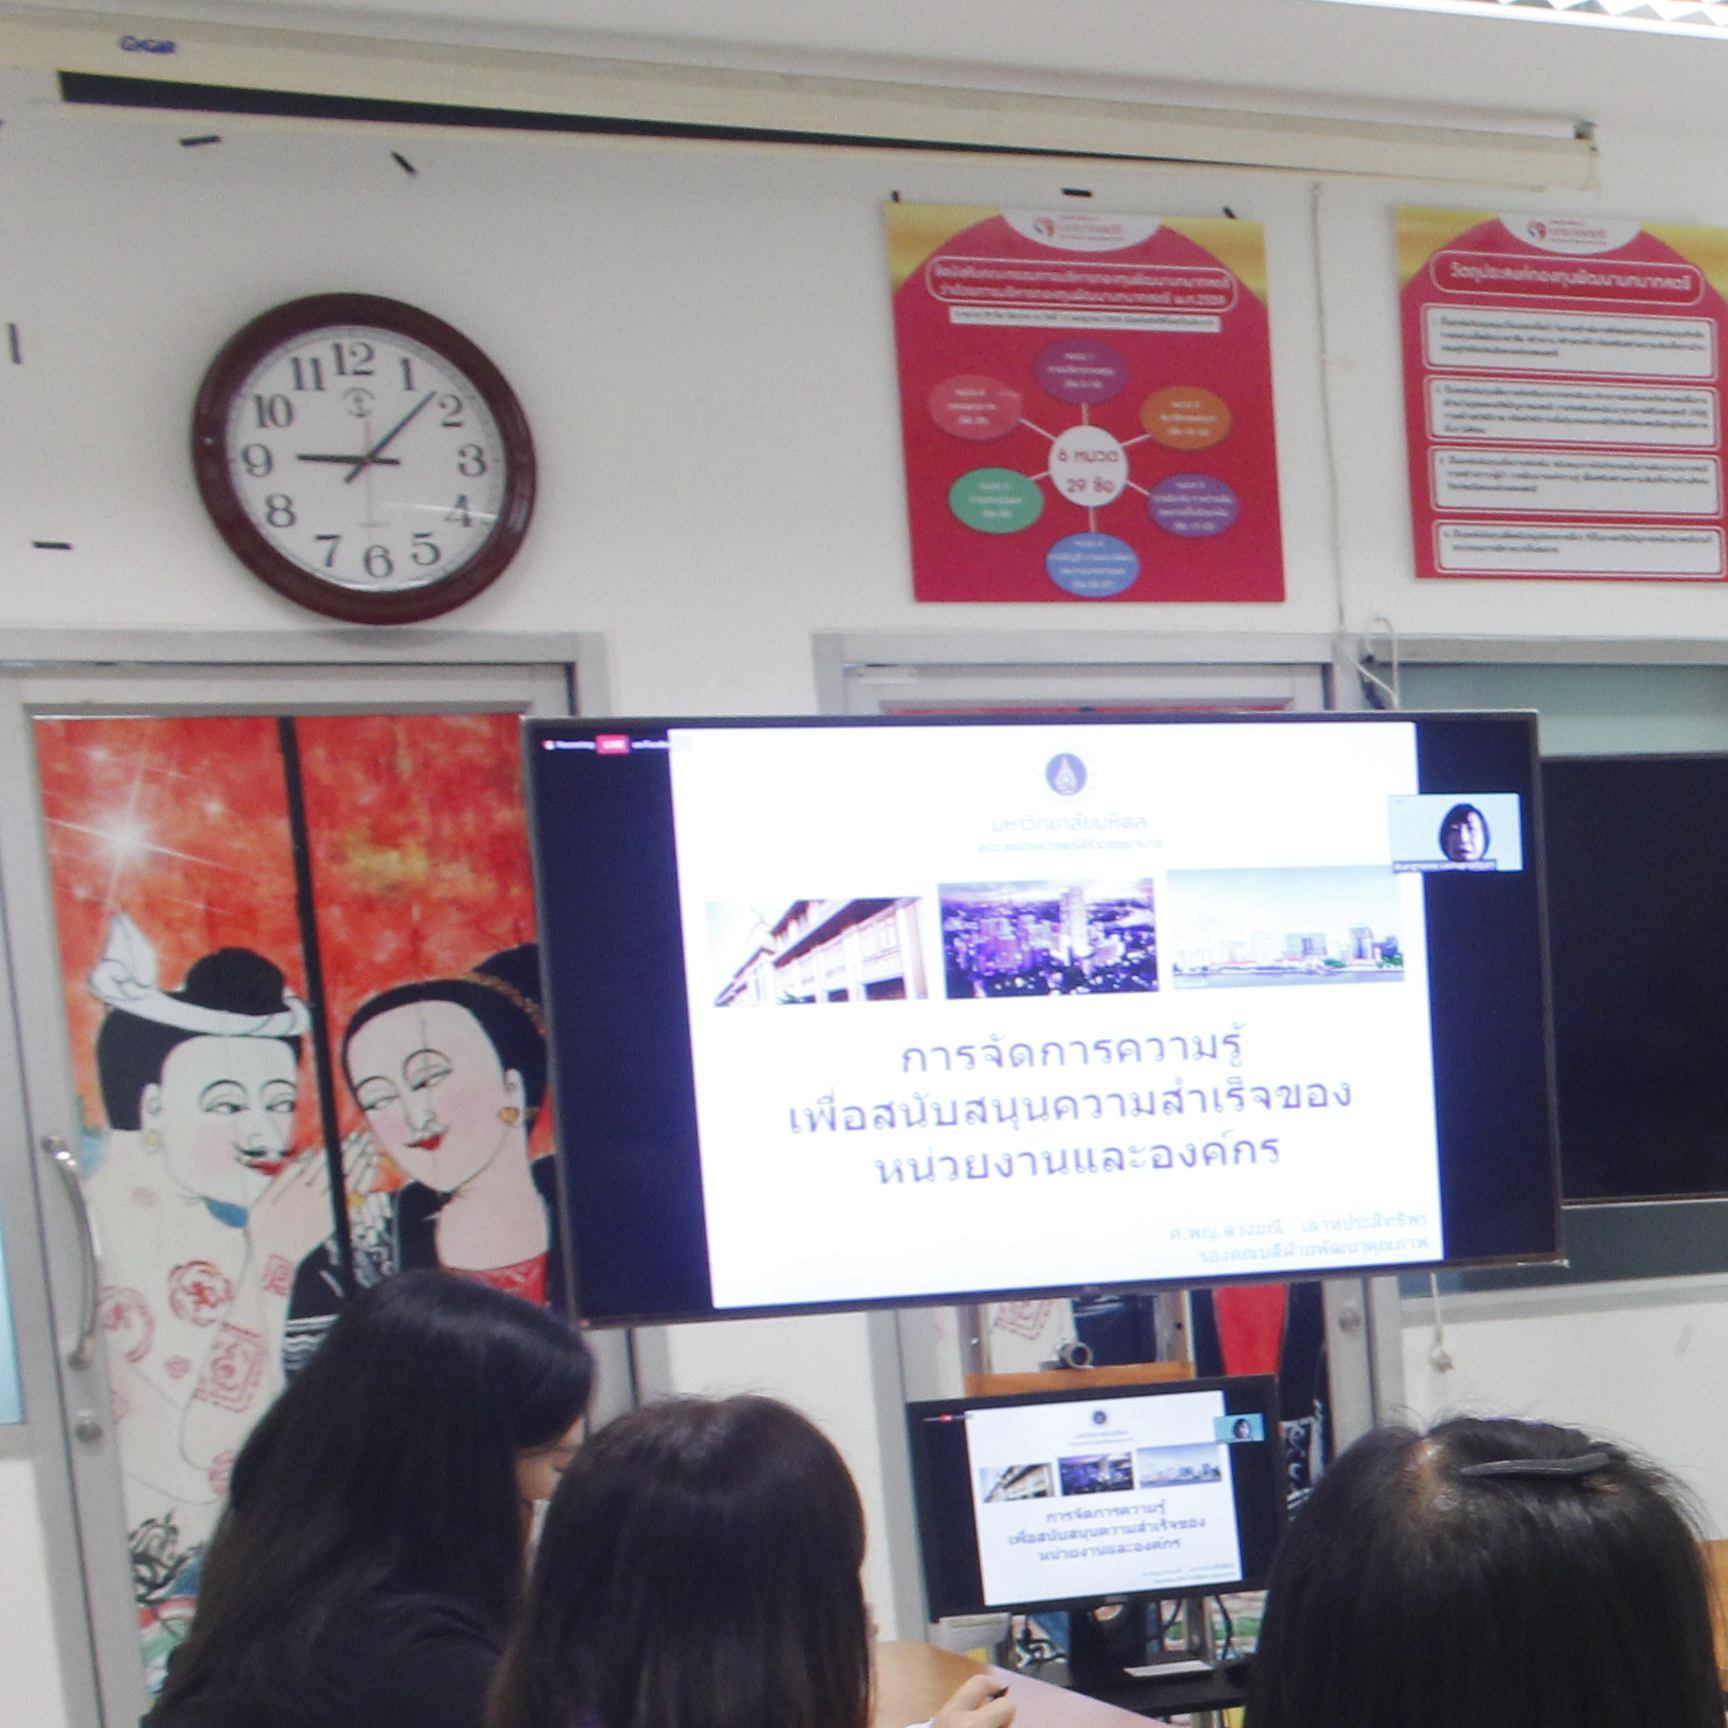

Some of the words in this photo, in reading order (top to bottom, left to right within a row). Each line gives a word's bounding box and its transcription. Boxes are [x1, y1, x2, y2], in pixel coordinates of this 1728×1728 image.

[290, 356, 326, 391] 11
[331, 341, 375, 377] 12
[401, 356, 416, 391] 1
[253, 393, 294, 429] 10
[439, 394, 464, 428] 2
[240, 443, 273, 478] 9
[458, 444, 488, 477] 3
[265, 493, 297, 528] 8
[445, 494, 473, 528] 4
[314, 534, 343, 568] 7
[363, 545, 394, 578] 6
[411, 532, 441, 566] 5
[991, 811, 1147, 832] มหาวิทยาลัยมหิดล
[901, 1021, 1247, 1073] การจัดการความรู้
[789, 1076, 1352, 1134] เพื่อสนับสนุนความสำเร็จของ
[873, 1129, 1281, 1185] หน่วยงานและองค์กร
[1046, 1499, 1166, 1524] การจัดการความรู้
